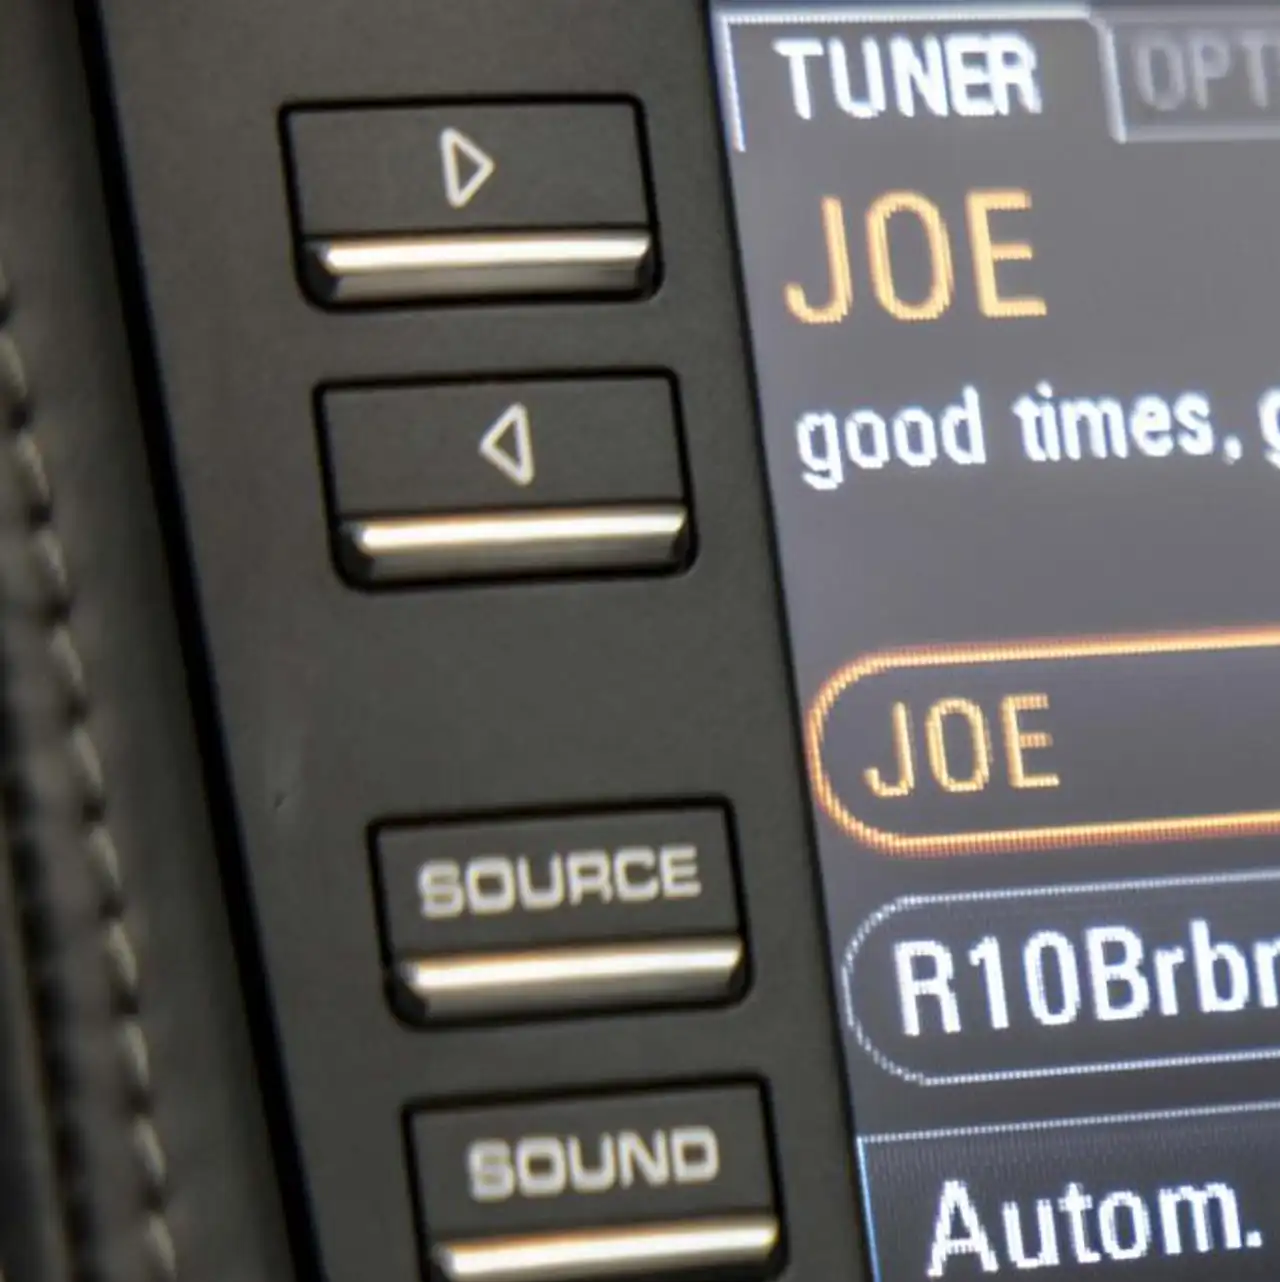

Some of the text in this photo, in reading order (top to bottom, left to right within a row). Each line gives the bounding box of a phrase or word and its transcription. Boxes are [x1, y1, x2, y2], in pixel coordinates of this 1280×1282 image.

[772, 32, 1043, 120] TUNER
[782, 189, 1047, 324] JOE
[796, 386, 987, 490] good
[1012, 380, 1243, 466] times,
[863, 692, 1060, 798] JOE
[417, 845, 703, 919] SOURCE
[467, 1125, 720, 1202] SOUND
[926, 1178, 1263, 1278] Autom.
